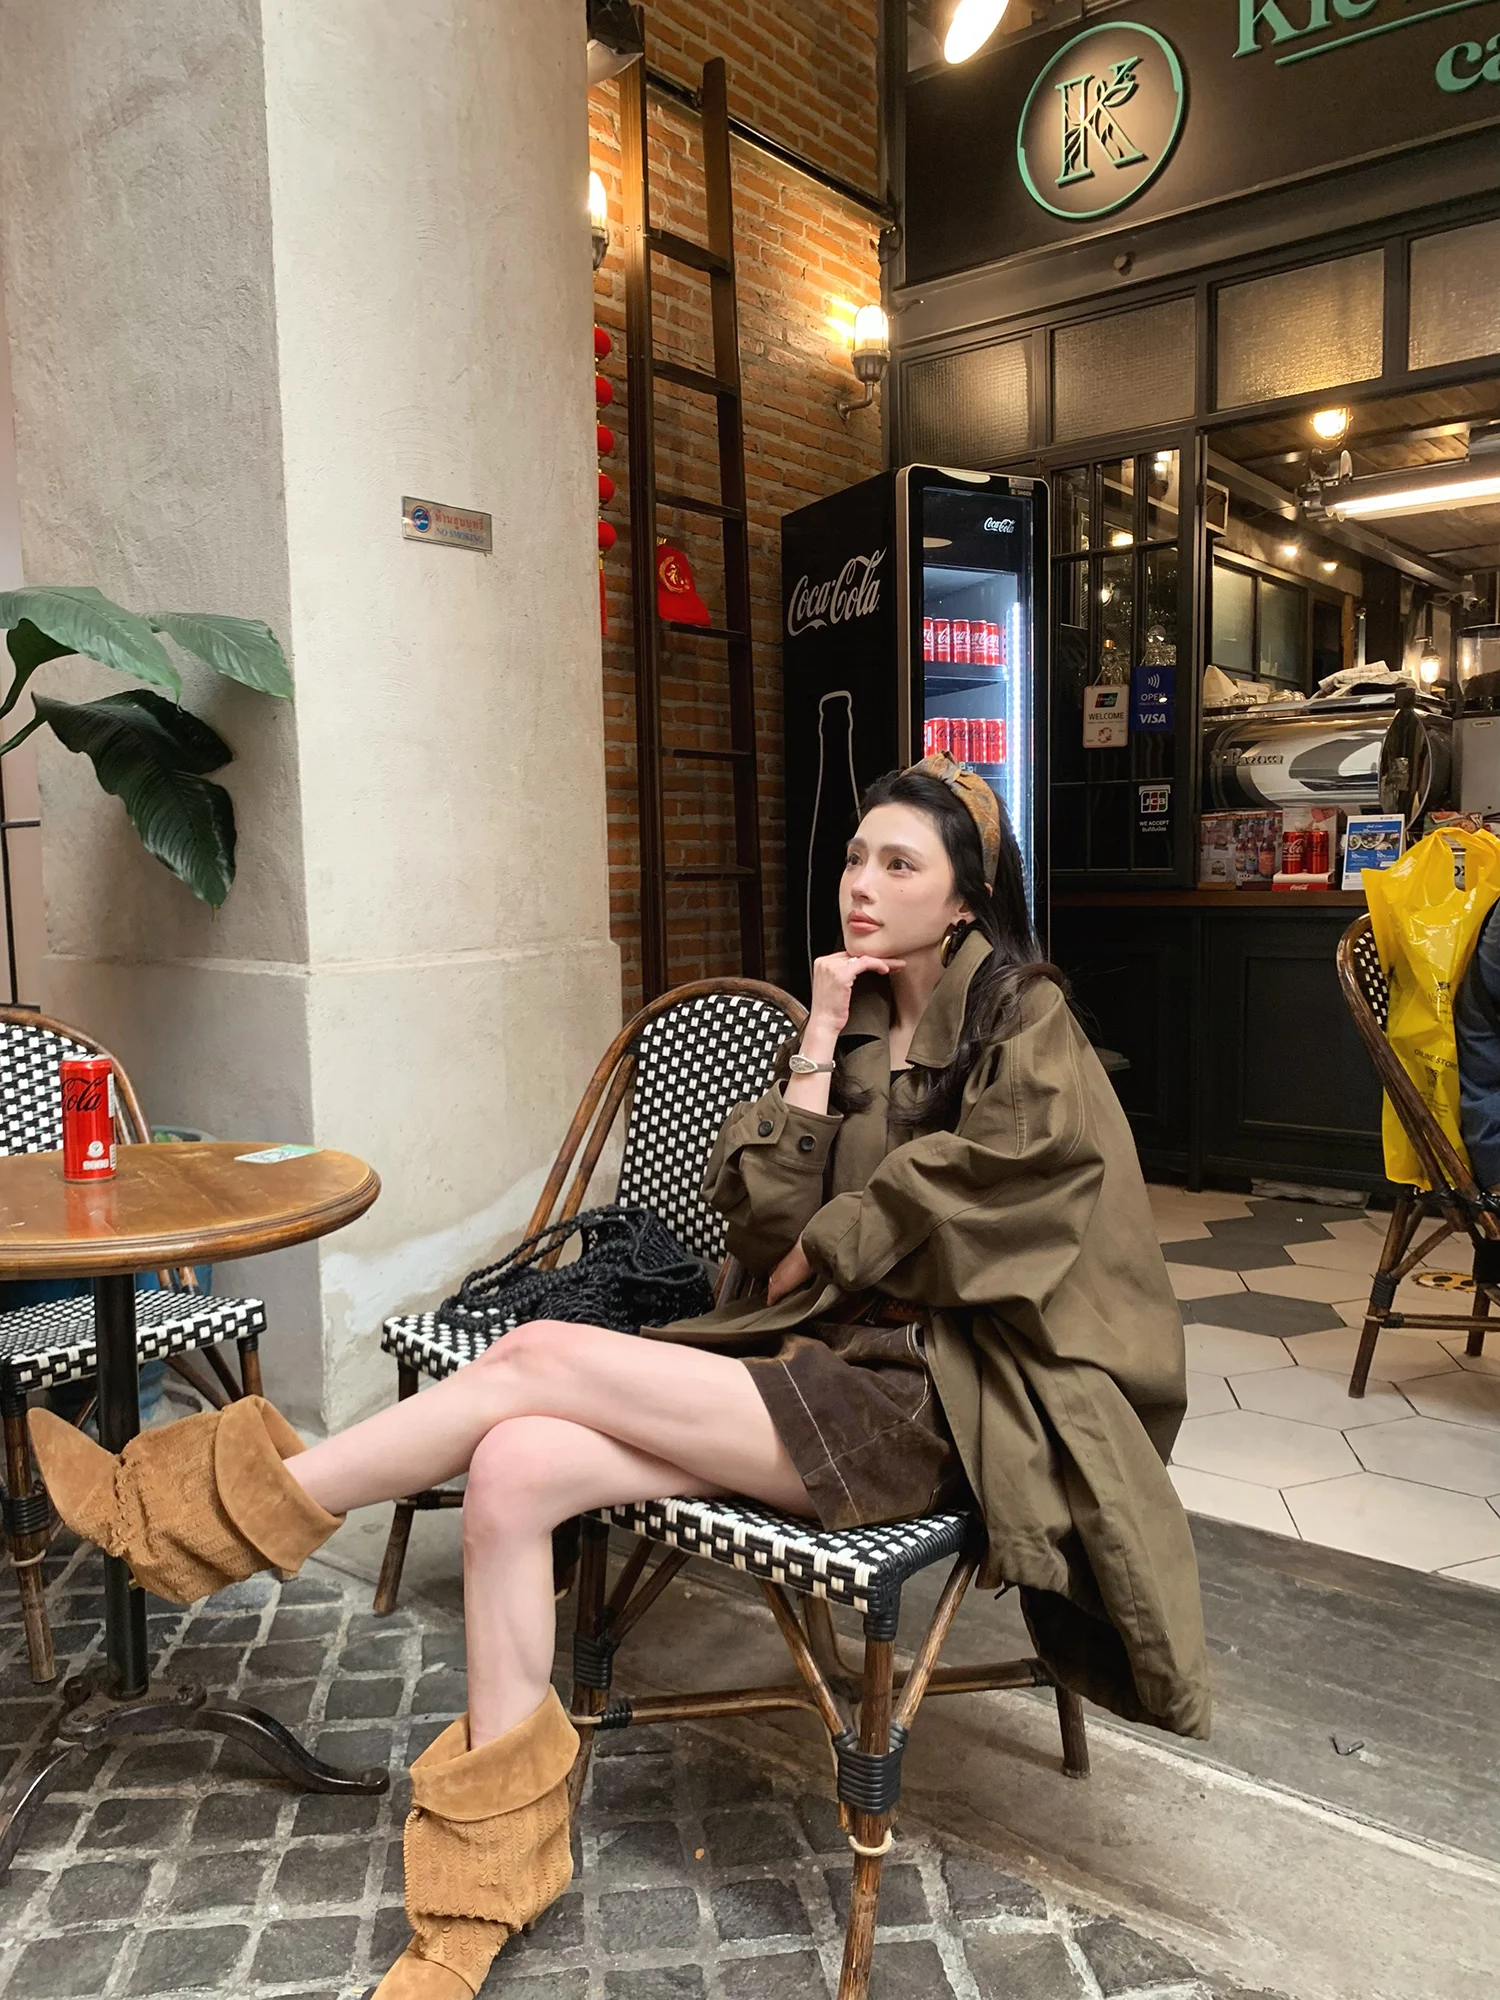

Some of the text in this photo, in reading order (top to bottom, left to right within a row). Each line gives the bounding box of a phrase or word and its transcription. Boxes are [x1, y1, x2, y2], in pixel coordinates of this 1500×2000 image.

[436, 526, 484, 544] NO SMOKING
[787, 547, 887, 636] Coca-Cola
[1088, 711, 1125, 721] WELCOME
[1139, 713, 1167, 724] VISA
